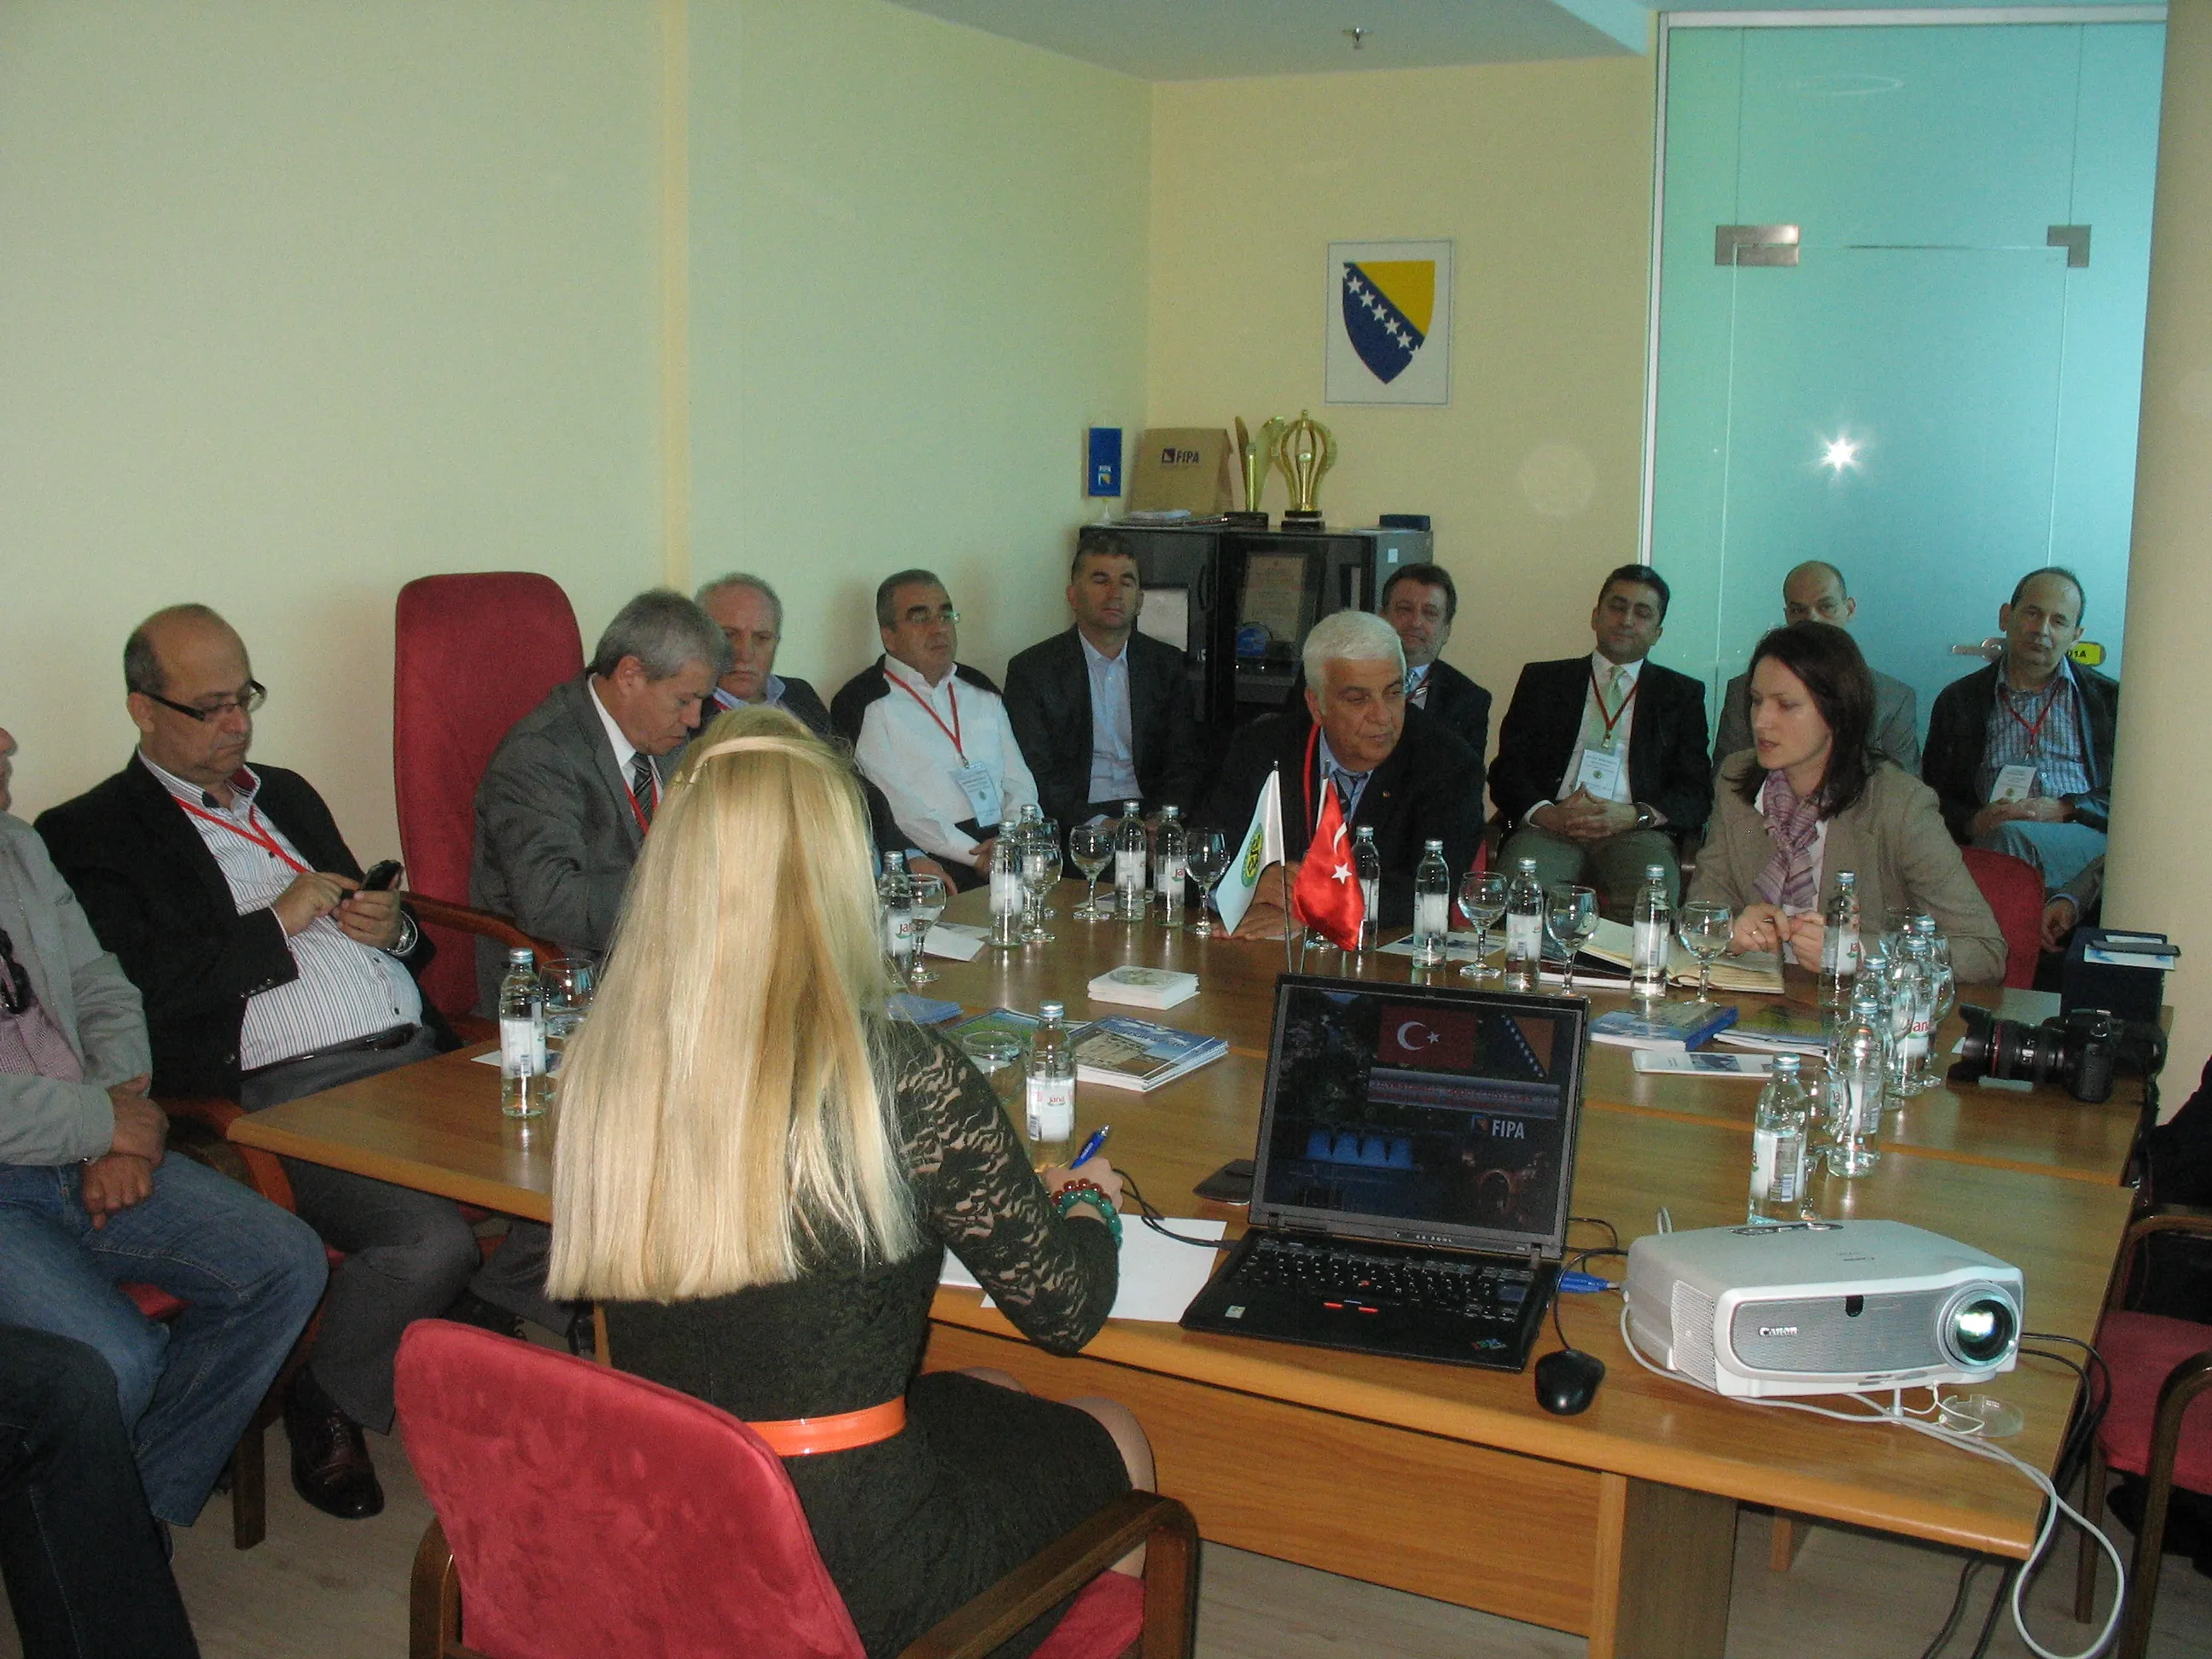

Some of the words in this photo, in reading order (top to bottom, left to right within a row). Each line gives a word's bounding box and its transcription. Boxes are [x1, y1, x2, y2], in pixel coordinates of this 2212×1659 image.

[1176, 450, 1200, 464] FIPA
[1492, 1119, 1525, 1138] FIPA
[1759, 1326, 1798, 1336] Canon
